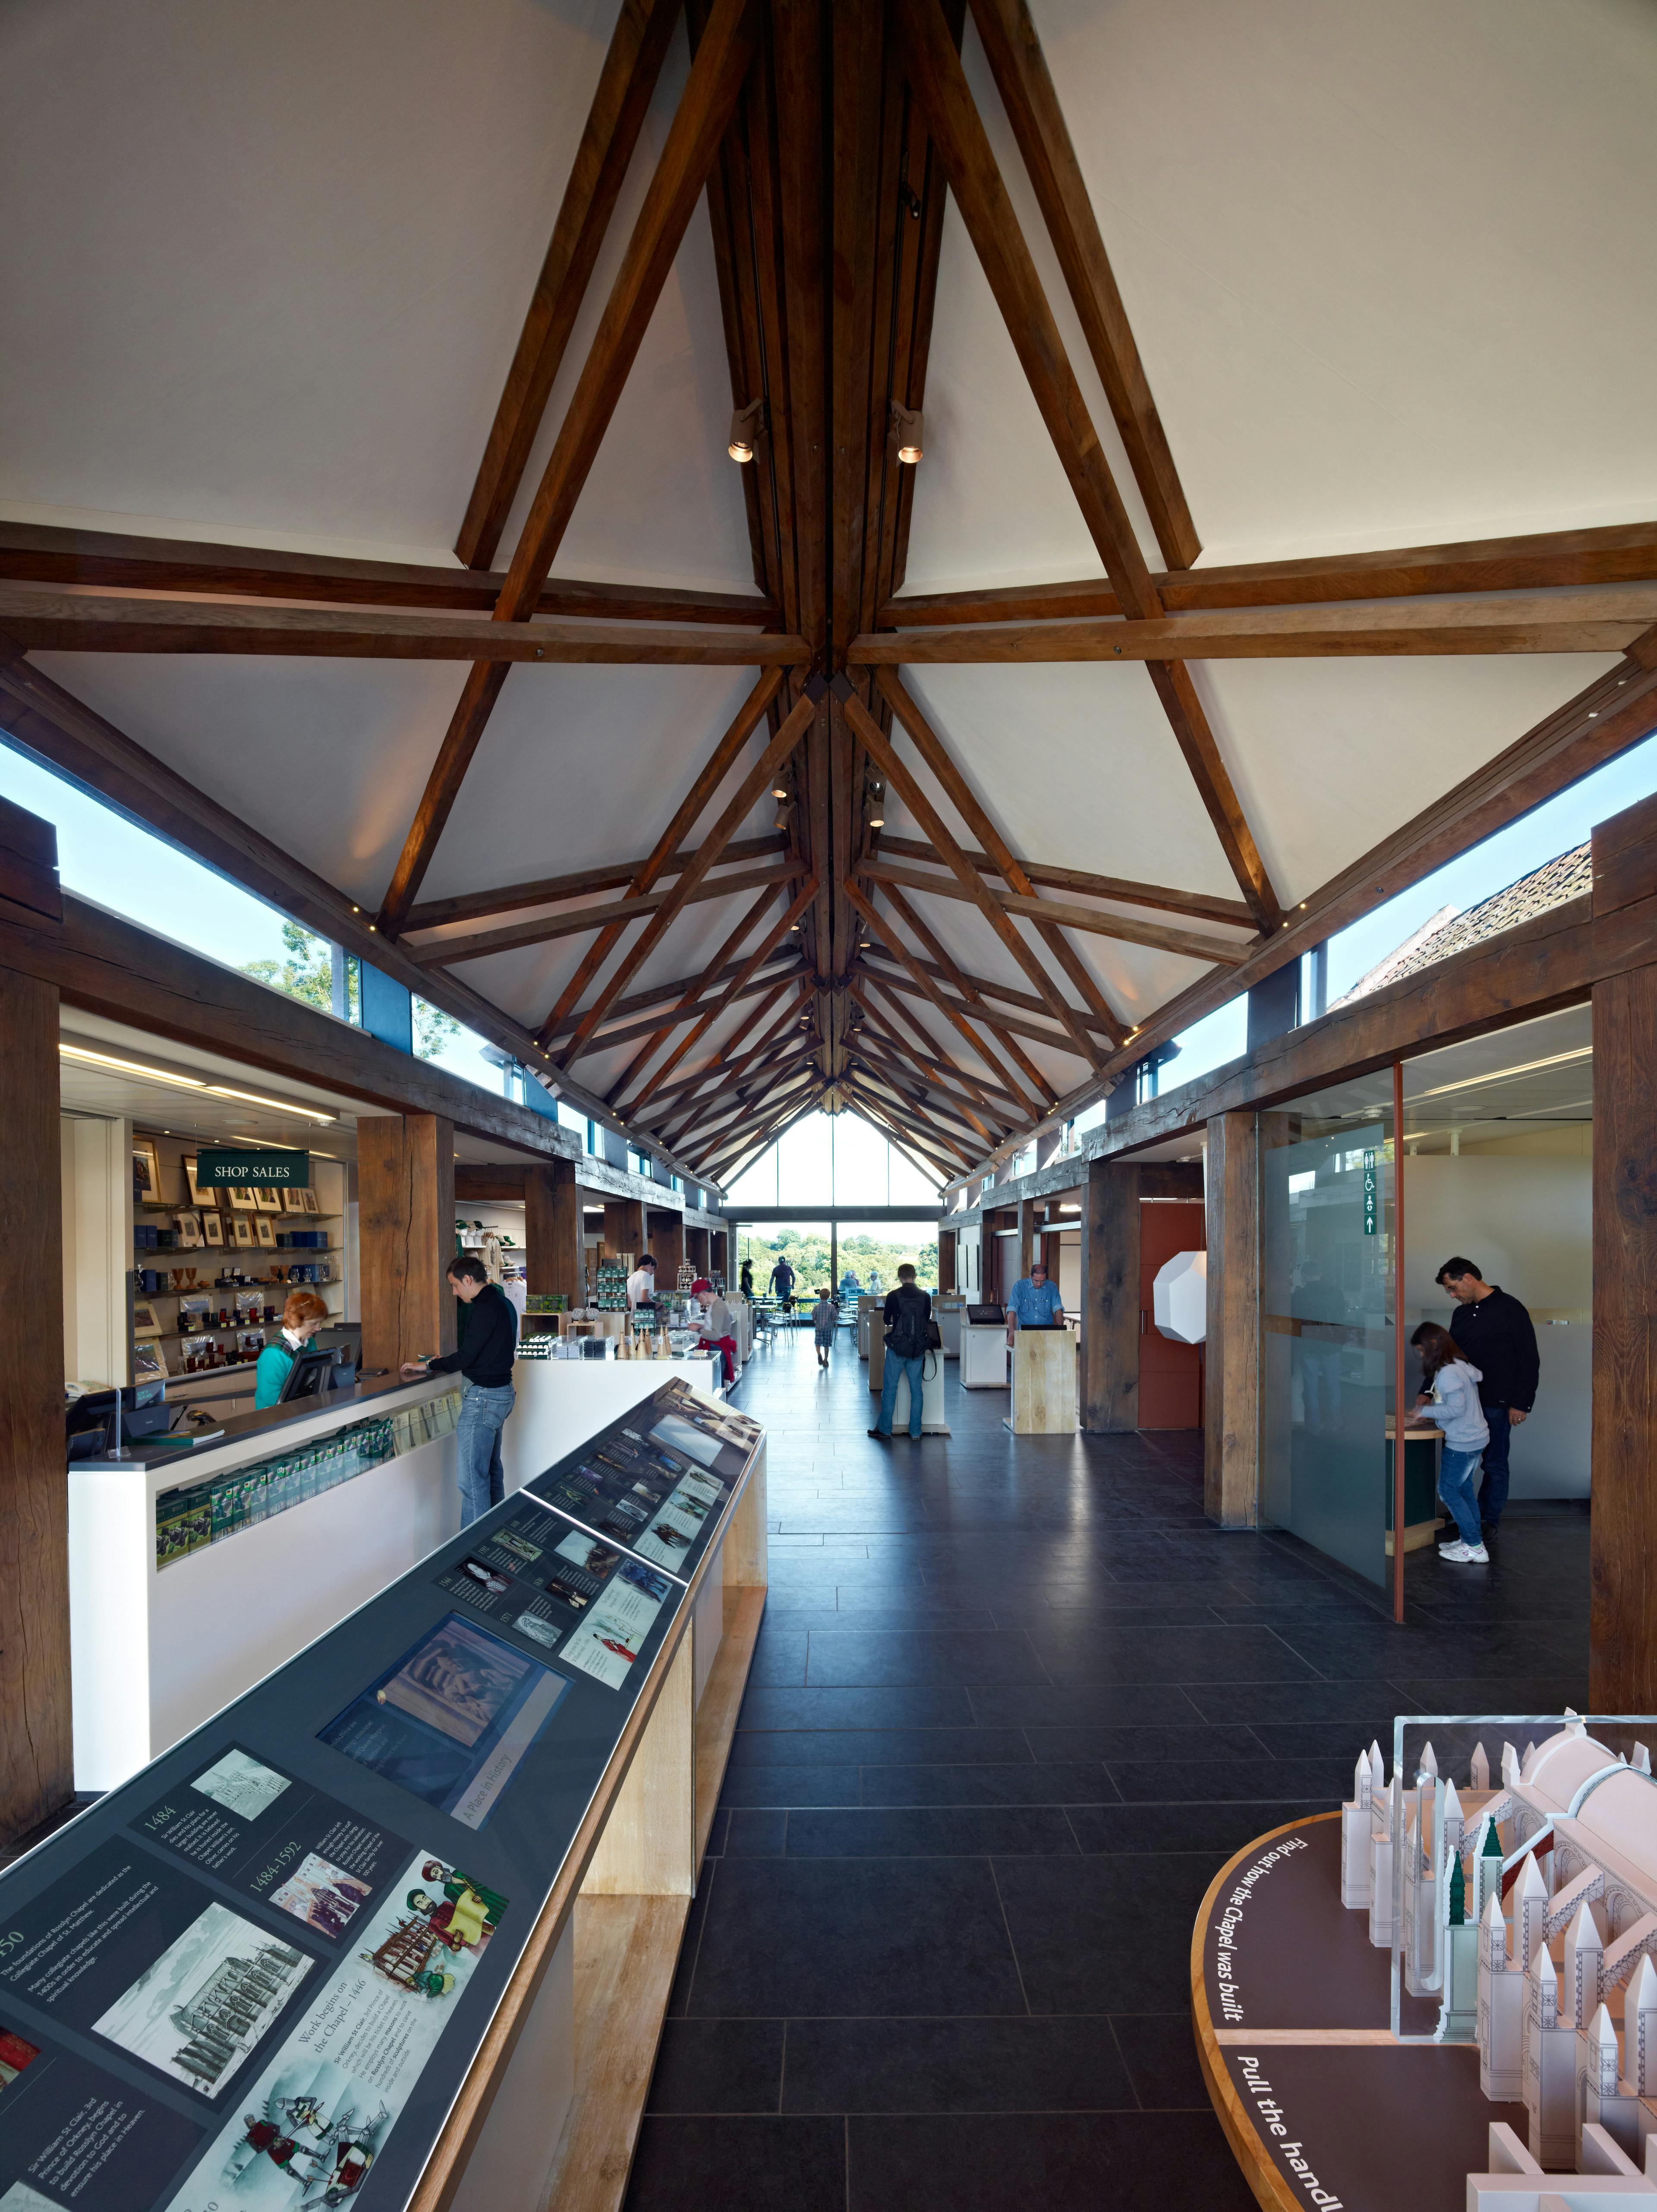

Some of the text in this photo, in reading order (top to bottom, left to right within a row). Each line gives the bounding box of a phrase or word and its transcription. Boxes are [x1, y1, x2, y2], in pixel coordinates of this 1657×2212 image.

[215, 1166, 290, 1178] SHOP SALES
[478, 1546, 490, 1554] 1592
[439, 1576, 453, 1587] 1544
[533, 1578, 544, 1587] 1630
[500, 1612, 513, 1623] 1571
[463, 1754, 512, 1821] A Place in History
[145, 1805, 177, 1831] 1484
[166, 1821, 183, 1833] William
[175, 1837, 188, 1847] larger
[186, 1824, 204, 1838] building
[207, 1811, 217, 1820] never
[190, 1816, 201, 1826] plans
[315, 1837, 328, 1849] William
[323, 1842, 334, 1853] enough
[332, 1831, 343, 1842] money
[250, 1841, 302, 1893] 1484-1592
[0, 1966, 14, 1975] The
[12, 1938, 46, 1966] foundations
[50, 1917, 72, 1933] Rosslyn
[70, 1901, 89, 1916] Chapel
[95, 1876, 118, 1896] dedicated
[10, 1957, 39, 1981] Collegiate
[37, 1940, 58, 1957] Chapel
[69, 1909, 94, 1929] Matthew.
[27, 1977, 46, 1992] Many
[45, 1954, 71, 1977] collegiate
[70, 1937, 89, 1954] chapels
[87, 1929, 98, 1937] like
[97, 1921, 108, 1929] this
[106, 1910, 119, 1921] were
[117, 1900, 130, 1911] built
[129, 1888, 145, 1901] during
[37, 1981, 56, 1996] 1400s
[61, 1962, 76, 1975] order
[82, 1938, 102, 1956] educate
[101, 1928, 112, 1938] and
[110, 1915, 127, 1930] spread
[124, 1893, 151, 1916] intellectual
[149, 1886, 158, 1894] and
[1215, 1837, 1309, 2022] Find out how the Chapel was built
[46, 1956, 98, 2002] spiritual knowledge.
[298, 1982, 347, 2042] Work begins on
[314, 2038, 328, 2053] the
[324, 2006, 348, 2036] Chapel
[348, 1978, 365, 1999] 1446
[338, 2036, 354, 2055] William
[356, 2017, 367, 2029] Clair,
[369, 1995, 380, 2008] Prince
[342, 2050, 357, 2068] Orkney,
[354, 2032, 368, 2049] decides
[368, 2013, 378, 2026] build
[378, 1994, 390, 2010] Chapel
[351, 2058, 362, 2073] which
[374, 2021, 384, 2034] ticket
[385, 2000, 398, 2015] heaven.
[364, 2049, 378, 2070] employs
[377, 2035, 387, 2049] many
[384, 2016, 397, 2035] masons
[399, 2000, 407, 2010] work
[371, 2055, 385, 2075] Rosslyn
[383, 2037, 396, 2055] Chapel
[403, 2010, 411, 2022] carve
[375, 2065, 391, 2088] hundreds
[392, 2033, 409, 2059] sculptures
[383, 2078, 395, 2093] inside
[398, 2049, 411, 2067] outside.
[1237, 2056, 1273, 2093] Pull
[1257, 2098, 1287, 2136] the
[28, 2097, 97, 2173] Sir William St Clair, 3rd
[38, 2100, 109, 2179] Prince of Orkney, begins
